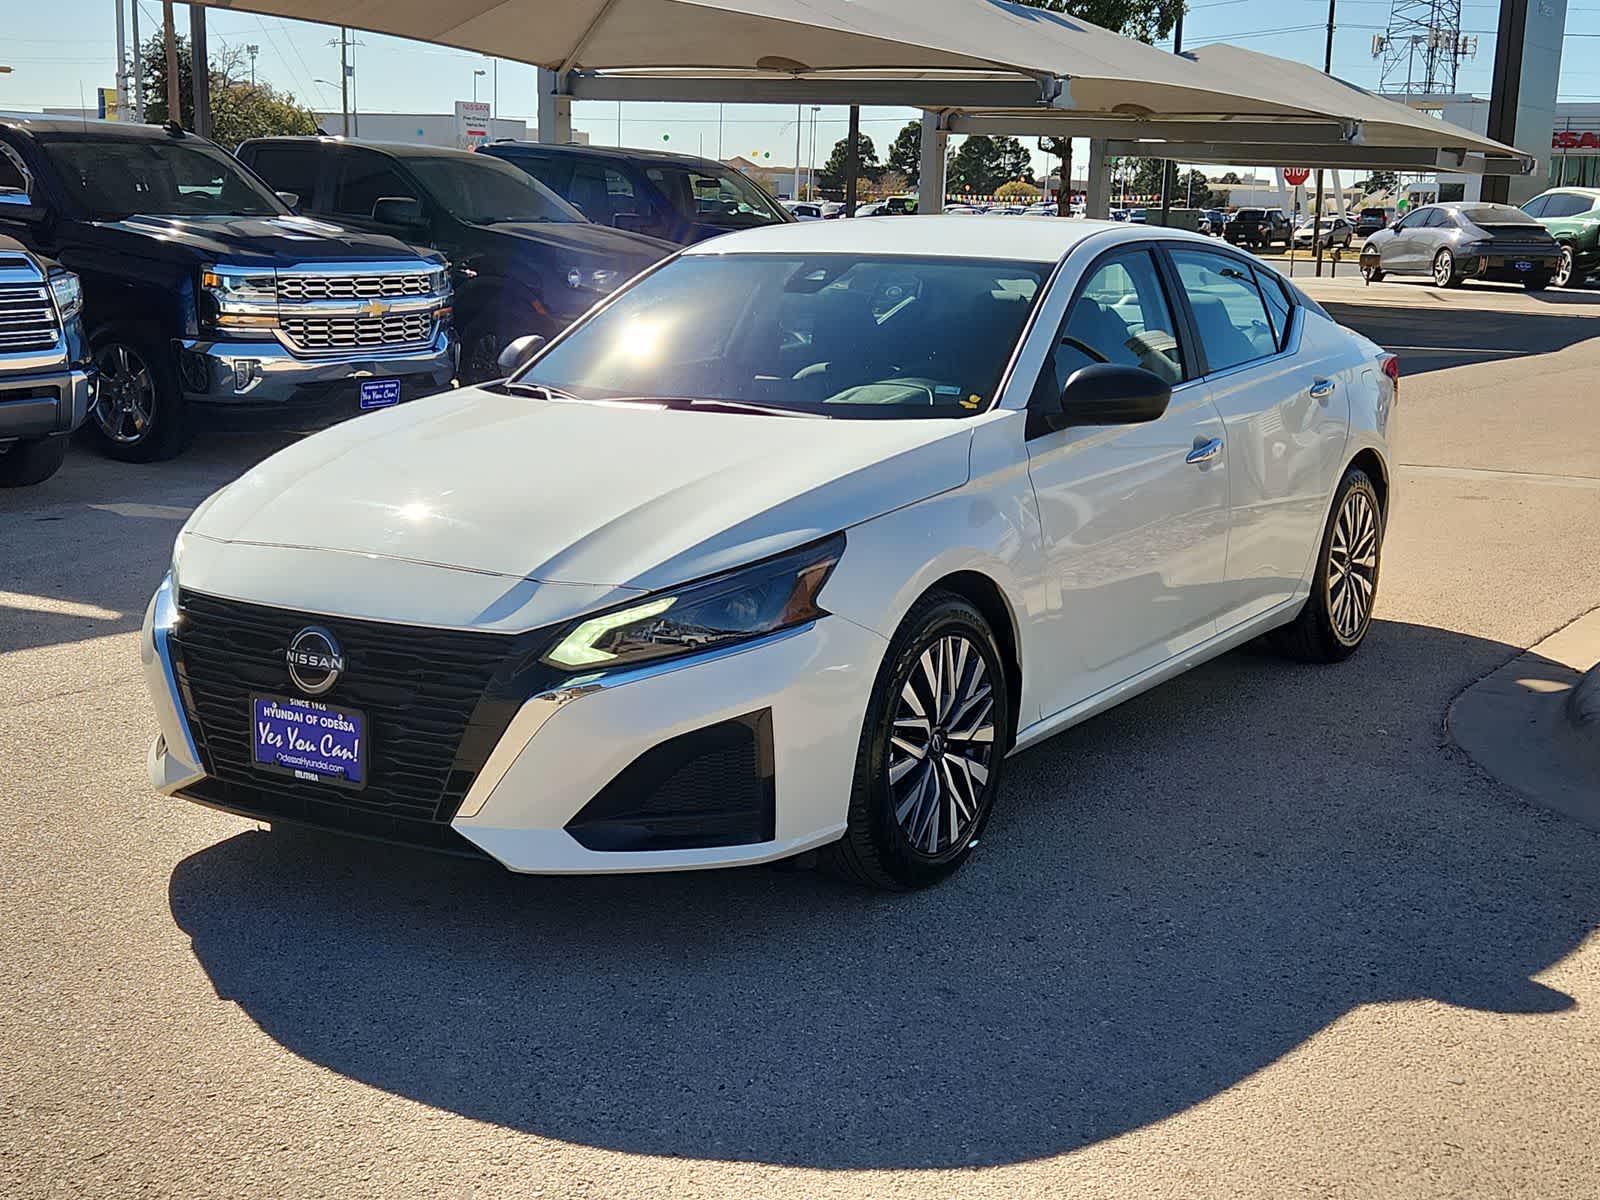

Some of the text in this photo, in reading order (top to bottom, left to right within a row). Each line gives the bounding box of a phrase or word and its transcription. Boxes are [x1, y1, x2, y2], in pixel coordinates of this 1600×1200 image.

[1285, 168, 1309, 176] STOP
[286, 651, 343, 669] NISSAN
[289, 698, 310, 709] SINCE
[263, 707, 355, 734] HYUNDAI OF ODESSA
[258, 721, 359, 763] Yes You Can!
